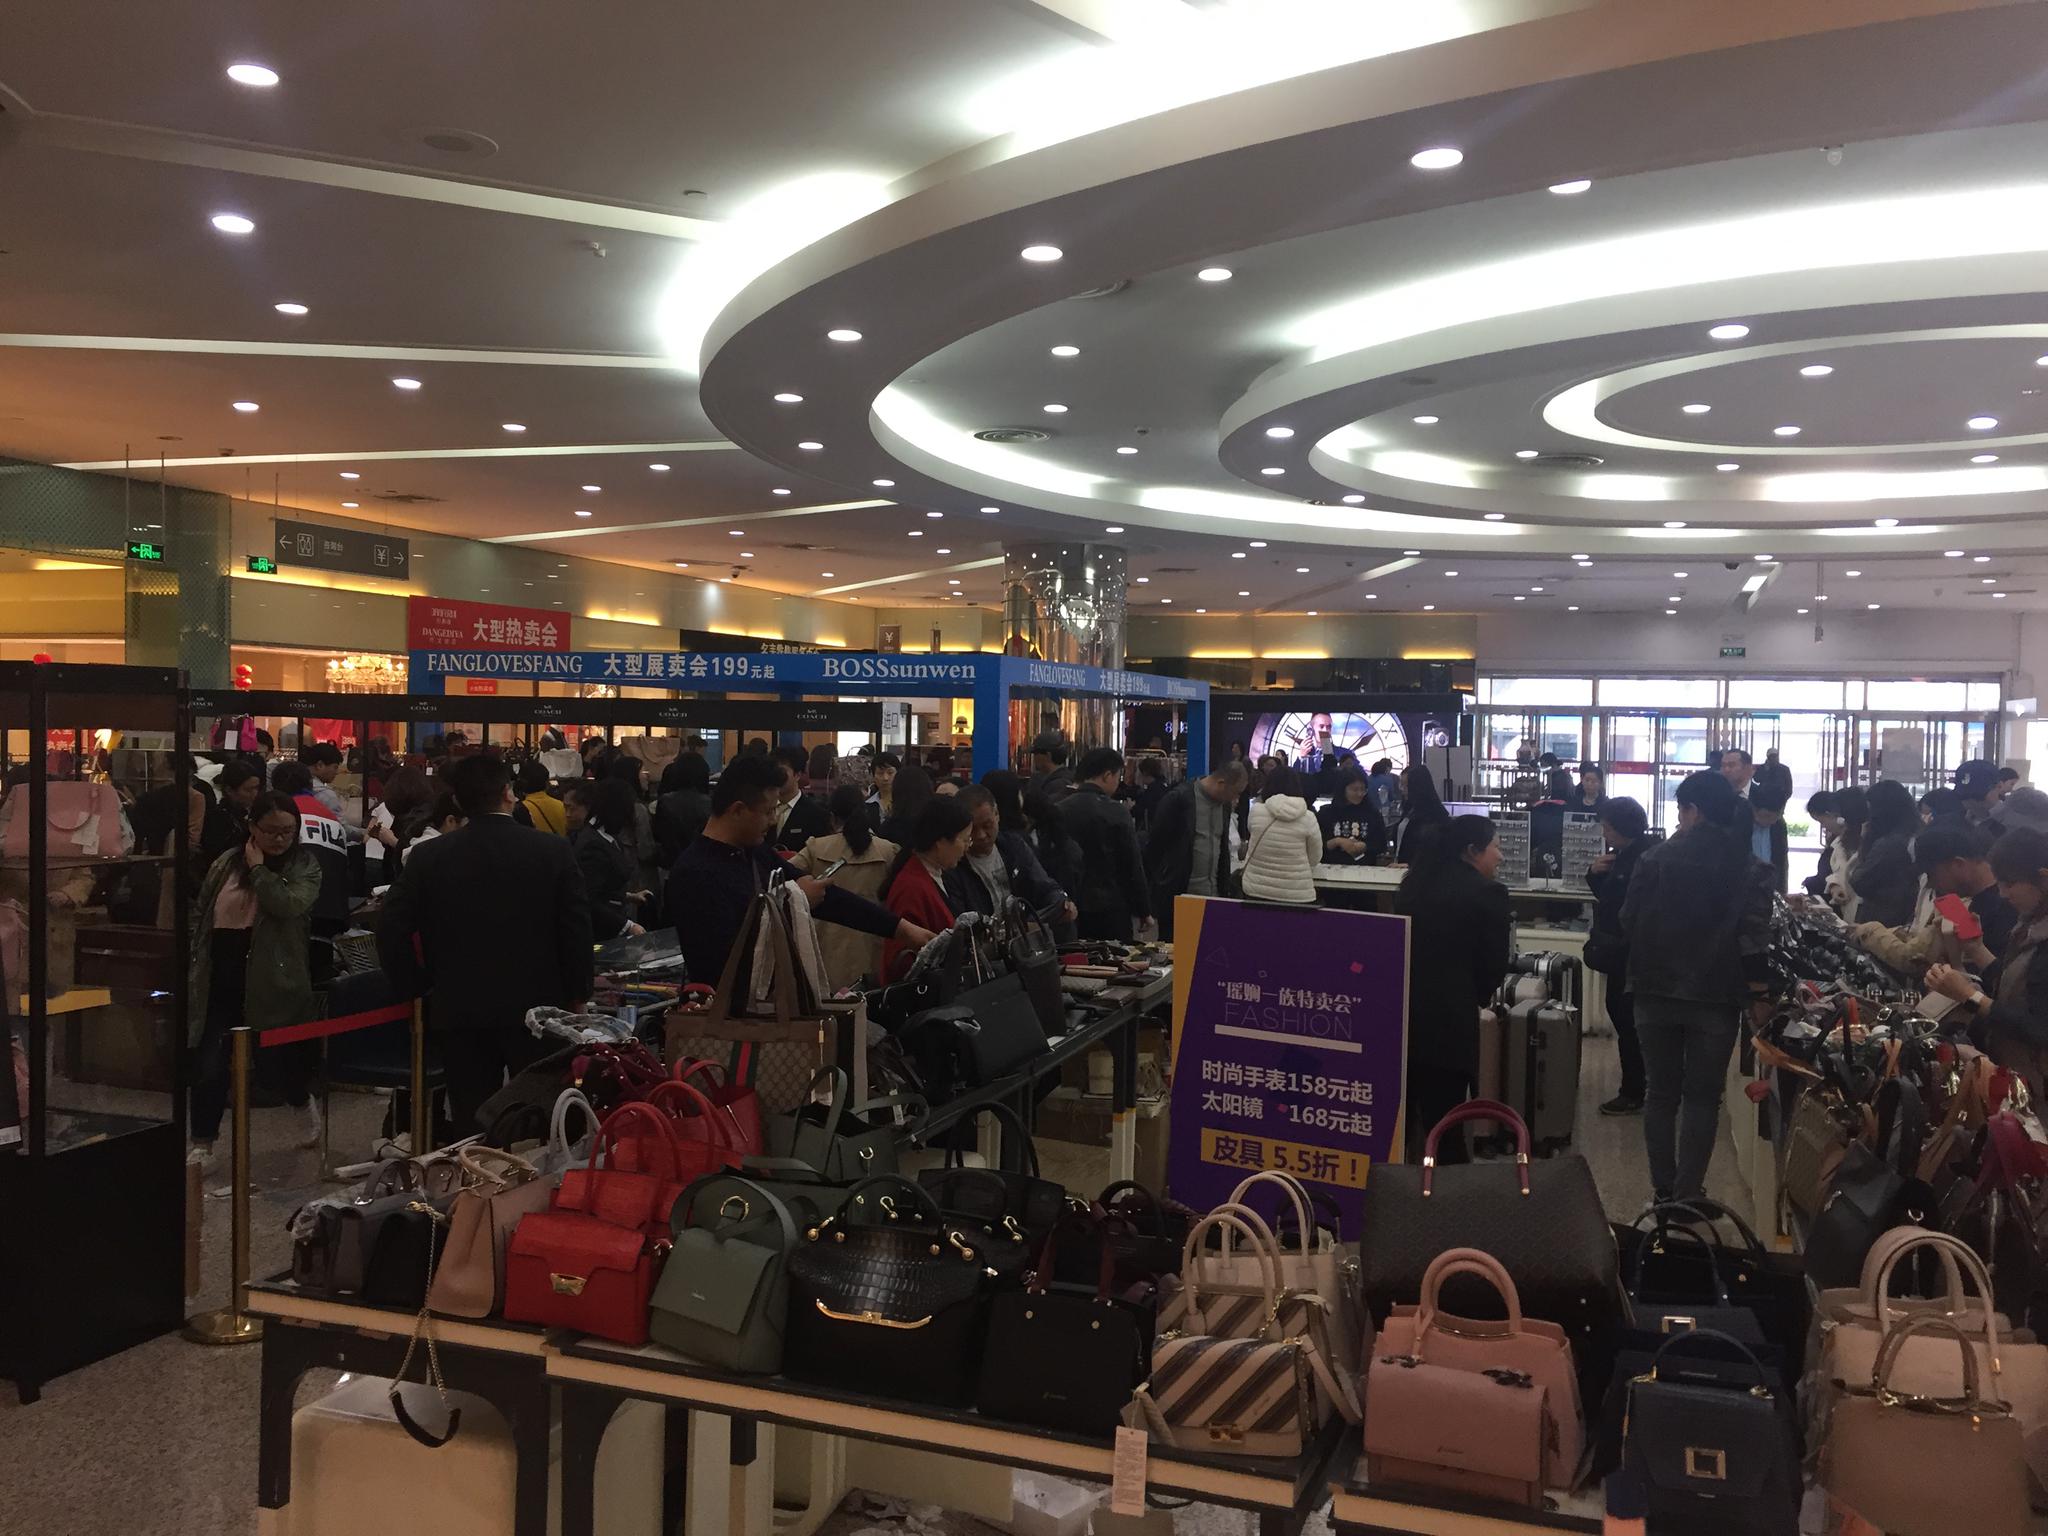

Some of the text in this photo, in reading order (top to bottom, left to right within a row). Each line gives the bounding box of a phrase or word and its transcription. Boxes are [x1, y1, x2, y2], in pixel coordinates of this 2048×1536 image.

[473, 617, 558, 648] 大型热卖会
[427, 653, 583, 674] FANGLOVESFANG
[822, 658, 976, 679] BOSSsunwen
[1029, 663, 1086, 687] FANGLOVESFANG
[304, 819, 346, 850] FILA
[1225, 1002, 1353, 1040] FASHION
[1202, 1060, 1373, 1105] 时尚手表158元起
[1202, 1090, 1373, 1136] 太阳镜 168元起
[1213, 1135, 1265, 1168] 皮具
